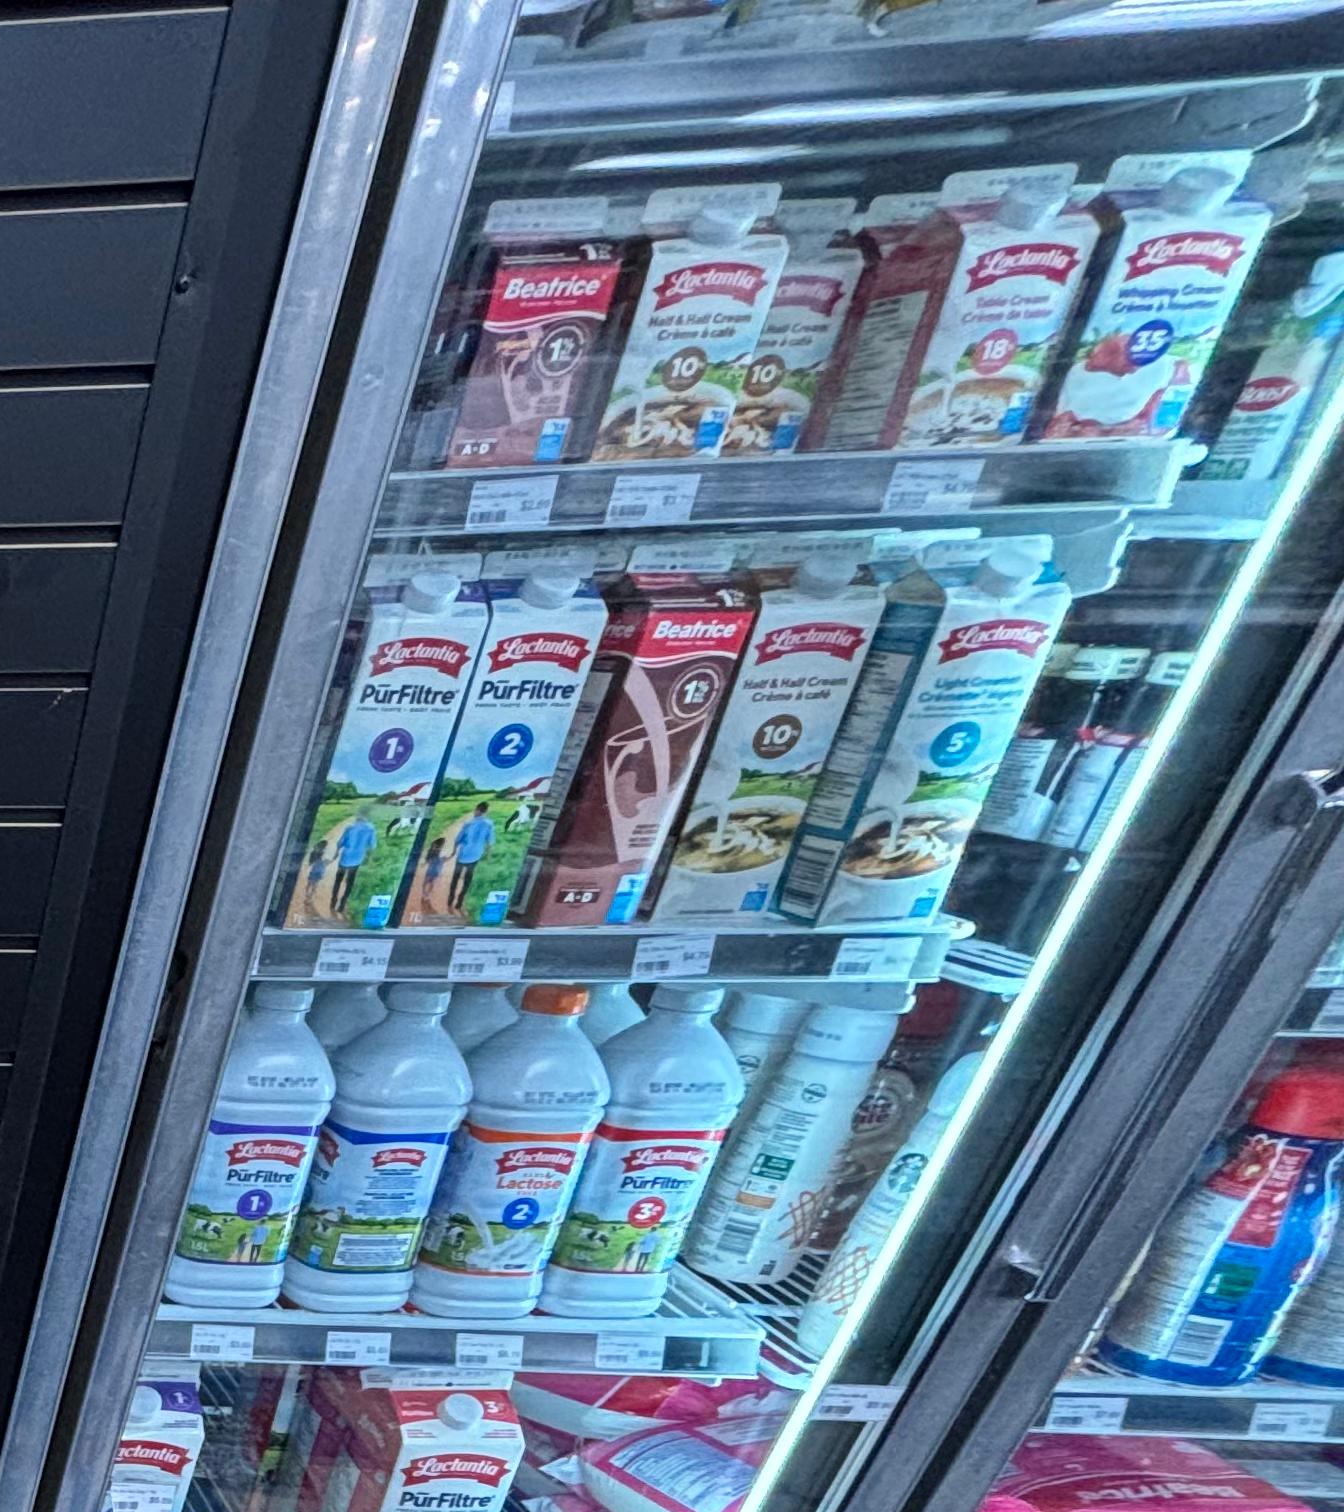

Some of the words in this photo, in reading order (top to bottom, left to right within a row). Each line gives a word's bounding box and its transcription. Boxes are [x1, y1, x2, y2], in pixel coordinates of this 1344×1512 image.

[977, 249, 1072, 278] Lactantia
[1137, 238, 1233, 267] Lactantia
[503, 273, 601, 299] Beatrice
[665, 269, 757, 296] Lactantia
[652, 620, 737, 639] Beatrice
[765, 628, 856, 653] Lactantia
[951, 624, 1043, 650] Lactantia
[379, 642, 461, 665] Lactantia
[498, 637, 580, 660] Lactantia
[234, 1142, 302, 1159] Lactantia
[504, 1150, 573, 1167] Lactantia
[496, 1177, 563, 1190] Lactose
[413, 1457, 500, 1477] Lactantia
[1075, 1482, 1246, 1504] Beatrice
